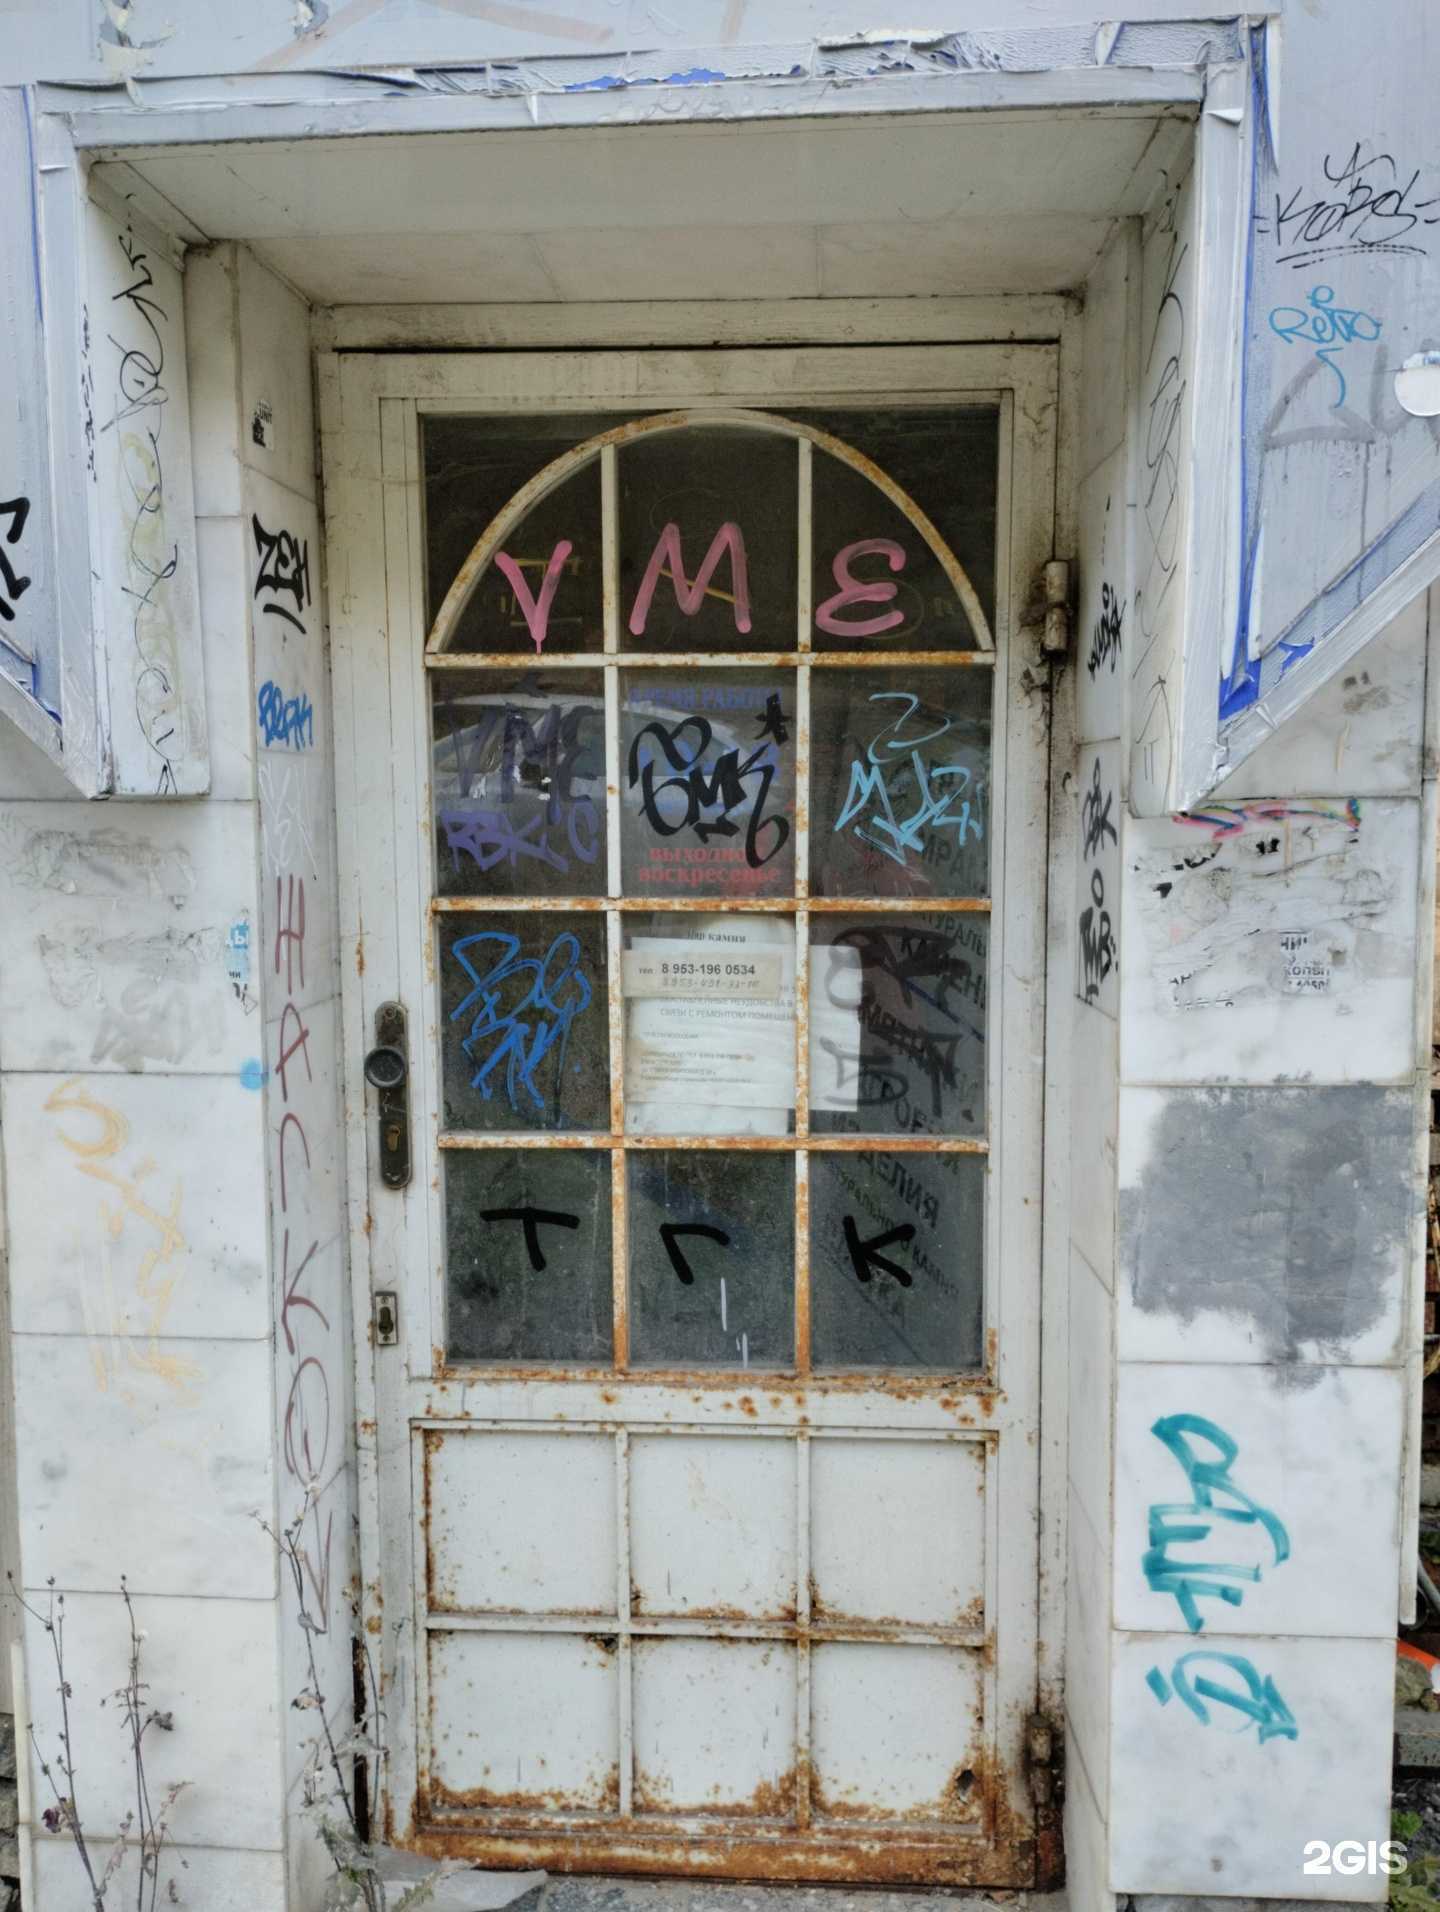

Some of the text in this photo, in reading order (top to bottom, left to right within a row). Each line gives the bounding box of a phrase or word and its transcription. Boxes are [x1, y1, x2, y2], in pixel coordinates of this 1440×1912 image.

[661, 963, 669, 974] 8
[673, 963, 721, 975] 953-196
[725, 964, 756, 975] 0534
